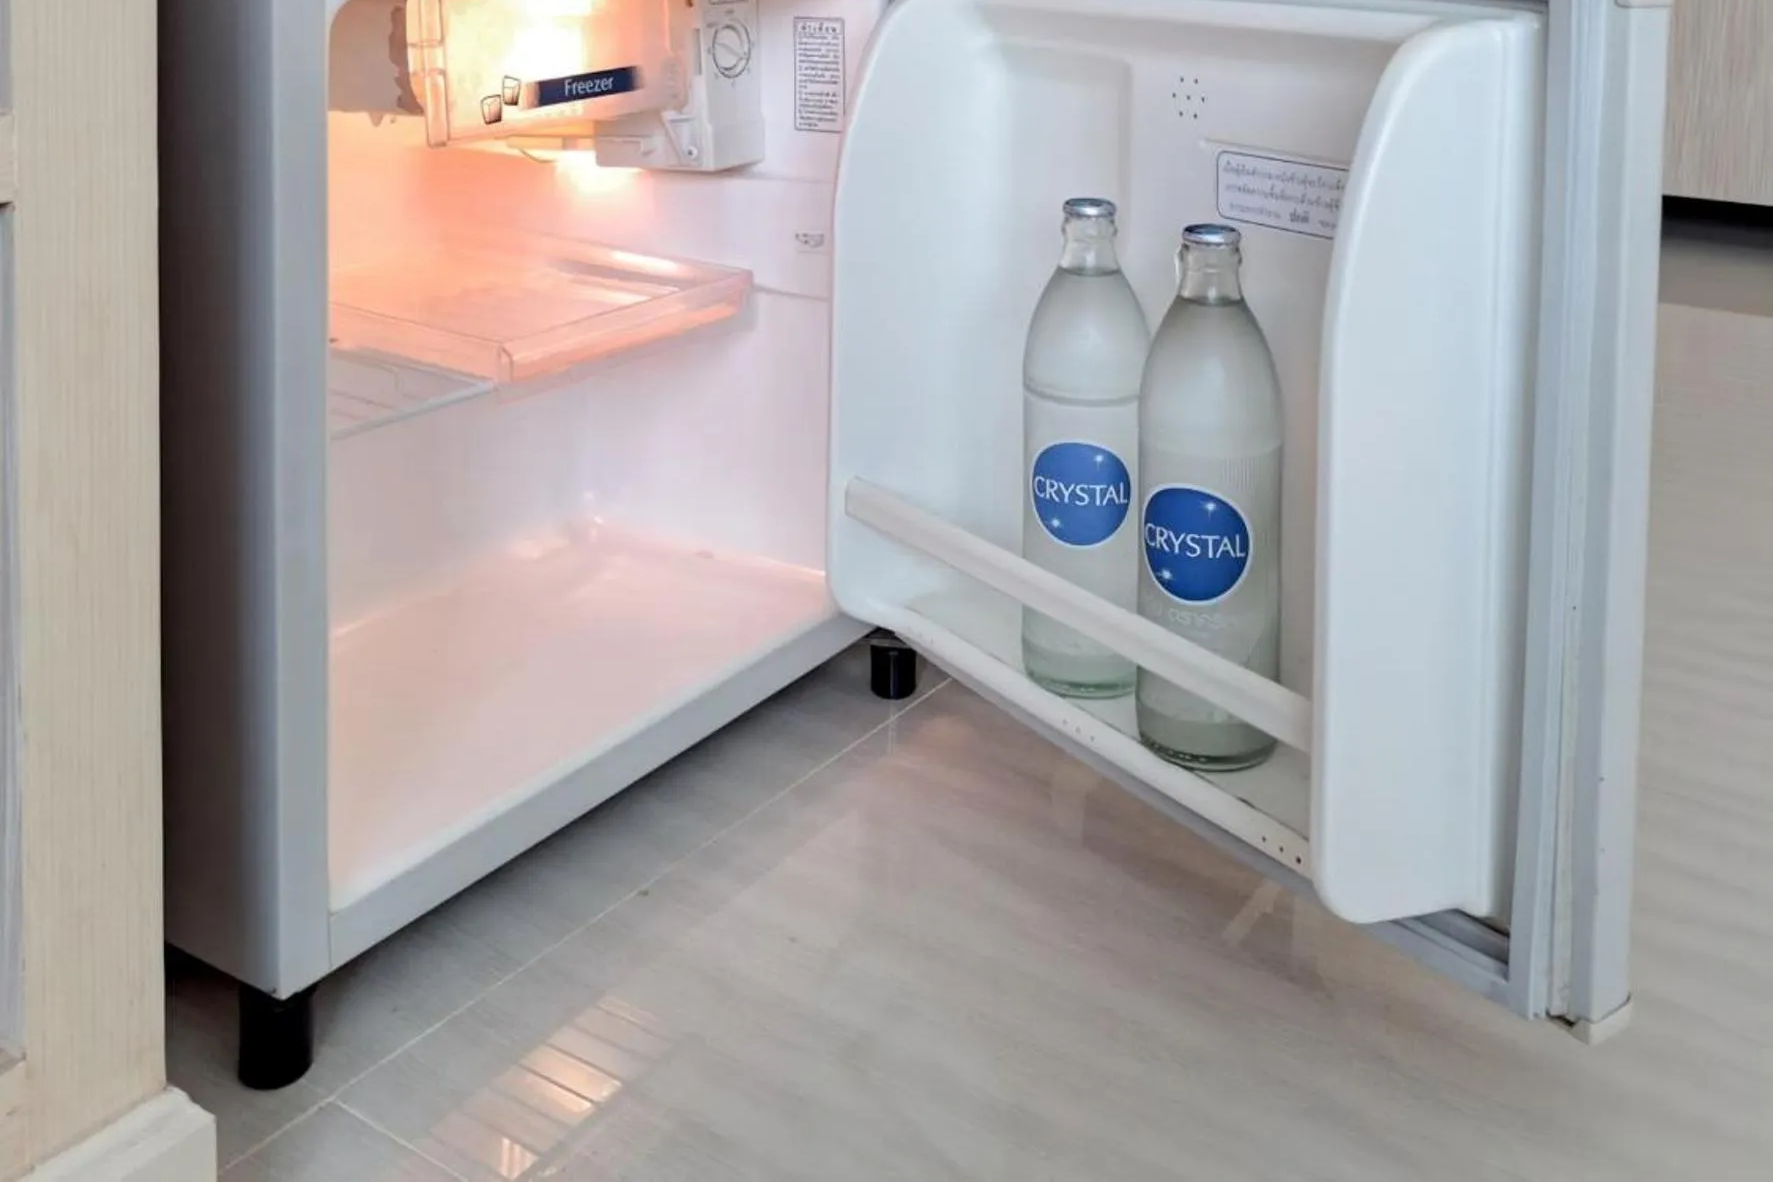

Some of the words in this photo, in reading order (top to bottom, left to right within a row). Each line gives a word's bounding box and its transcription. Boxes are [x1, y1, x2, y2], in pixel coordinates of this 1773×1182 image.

[564, 77, 615, 97] Freezer
[1034, 475, 1128, 507] CRYSTAL
[1145, 523, 1246, 559] CRYSTAL
